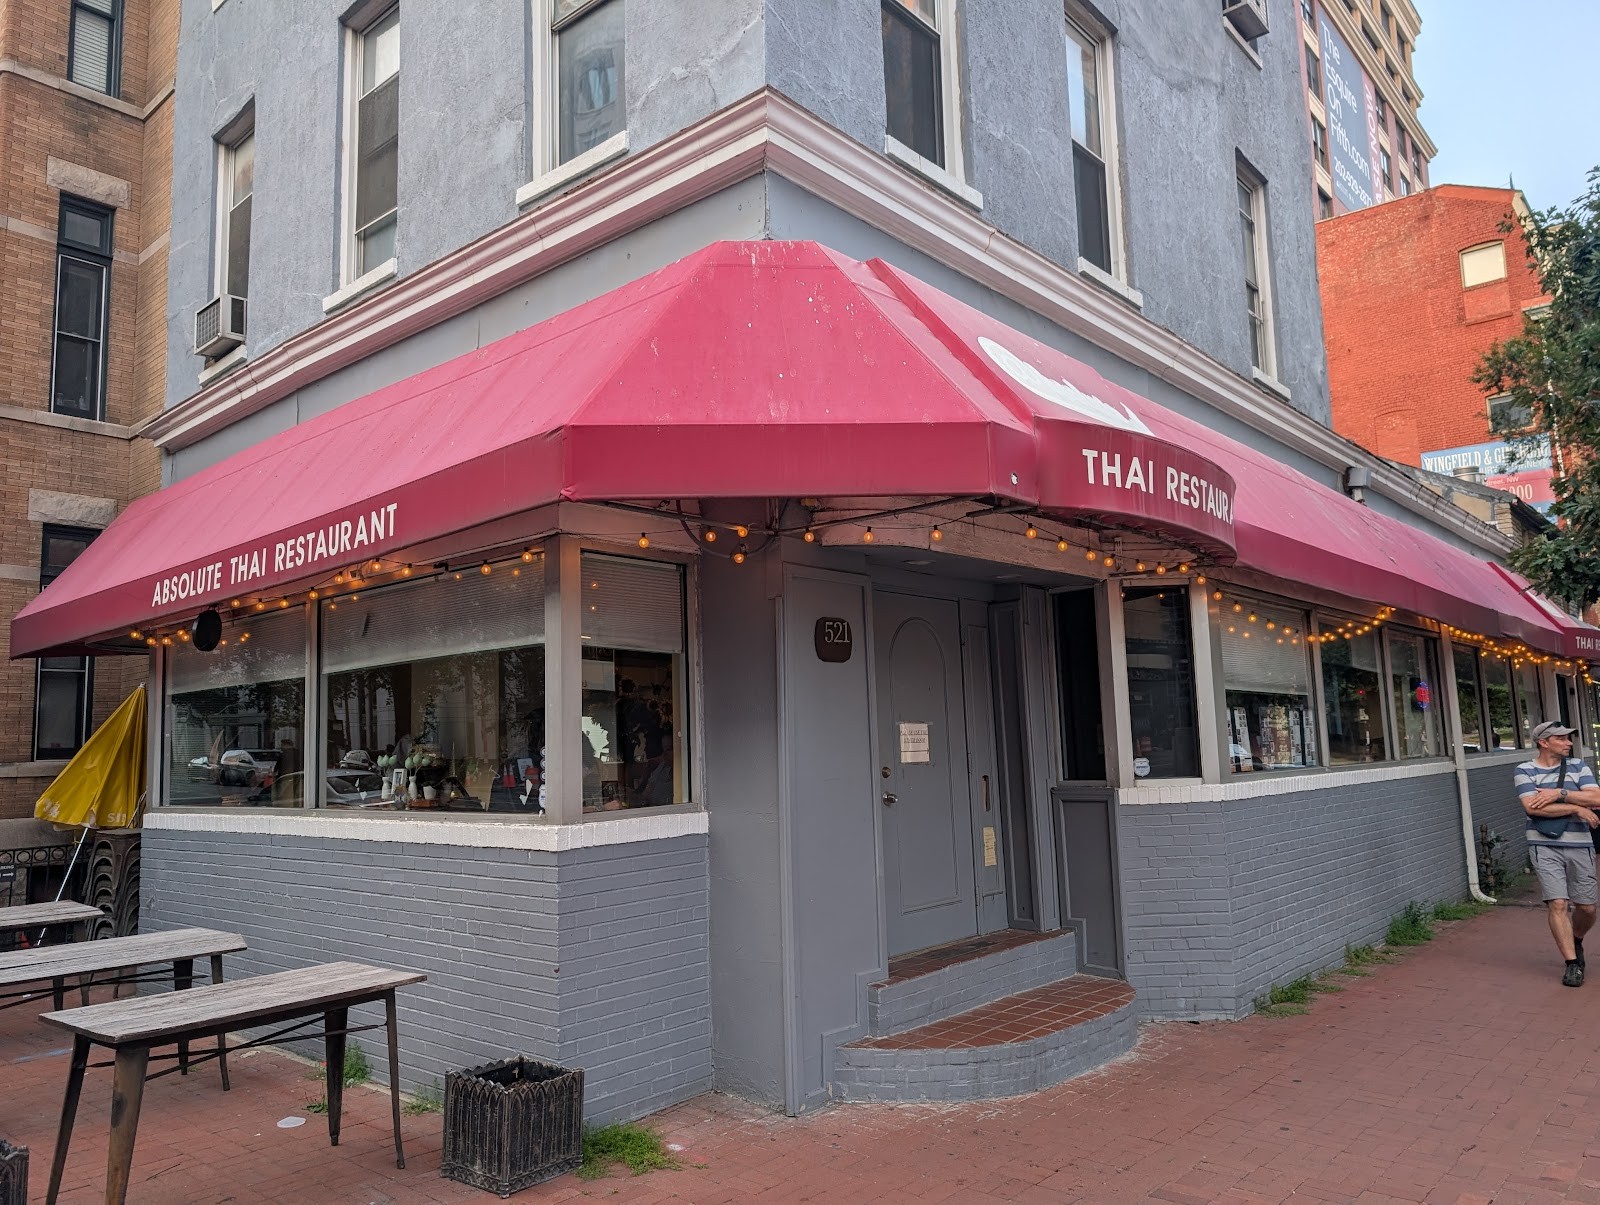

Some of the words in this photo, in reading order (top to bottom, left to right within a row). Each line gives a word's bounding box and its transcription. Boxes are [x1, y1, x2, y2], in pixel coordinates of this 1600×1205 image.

[1321, 21, 1340, 65] The
[1325, 51, 1357, 113] Esquire
[1327, 83, 1342, 119] On
[1082, 448, 1153, 494] THAI
[1424, 451, 1481, 472] WINGFIELD
[1484, 449, 1492, 465] &
[151, 562, 222, 607] ABSOLUTE
[230, 547, 267, 585] THAI
[274, 502, 397, 573] RESTAURANT
[825, 621, 850, 643] 521
[1575, 636, 1593, 650] THAI
